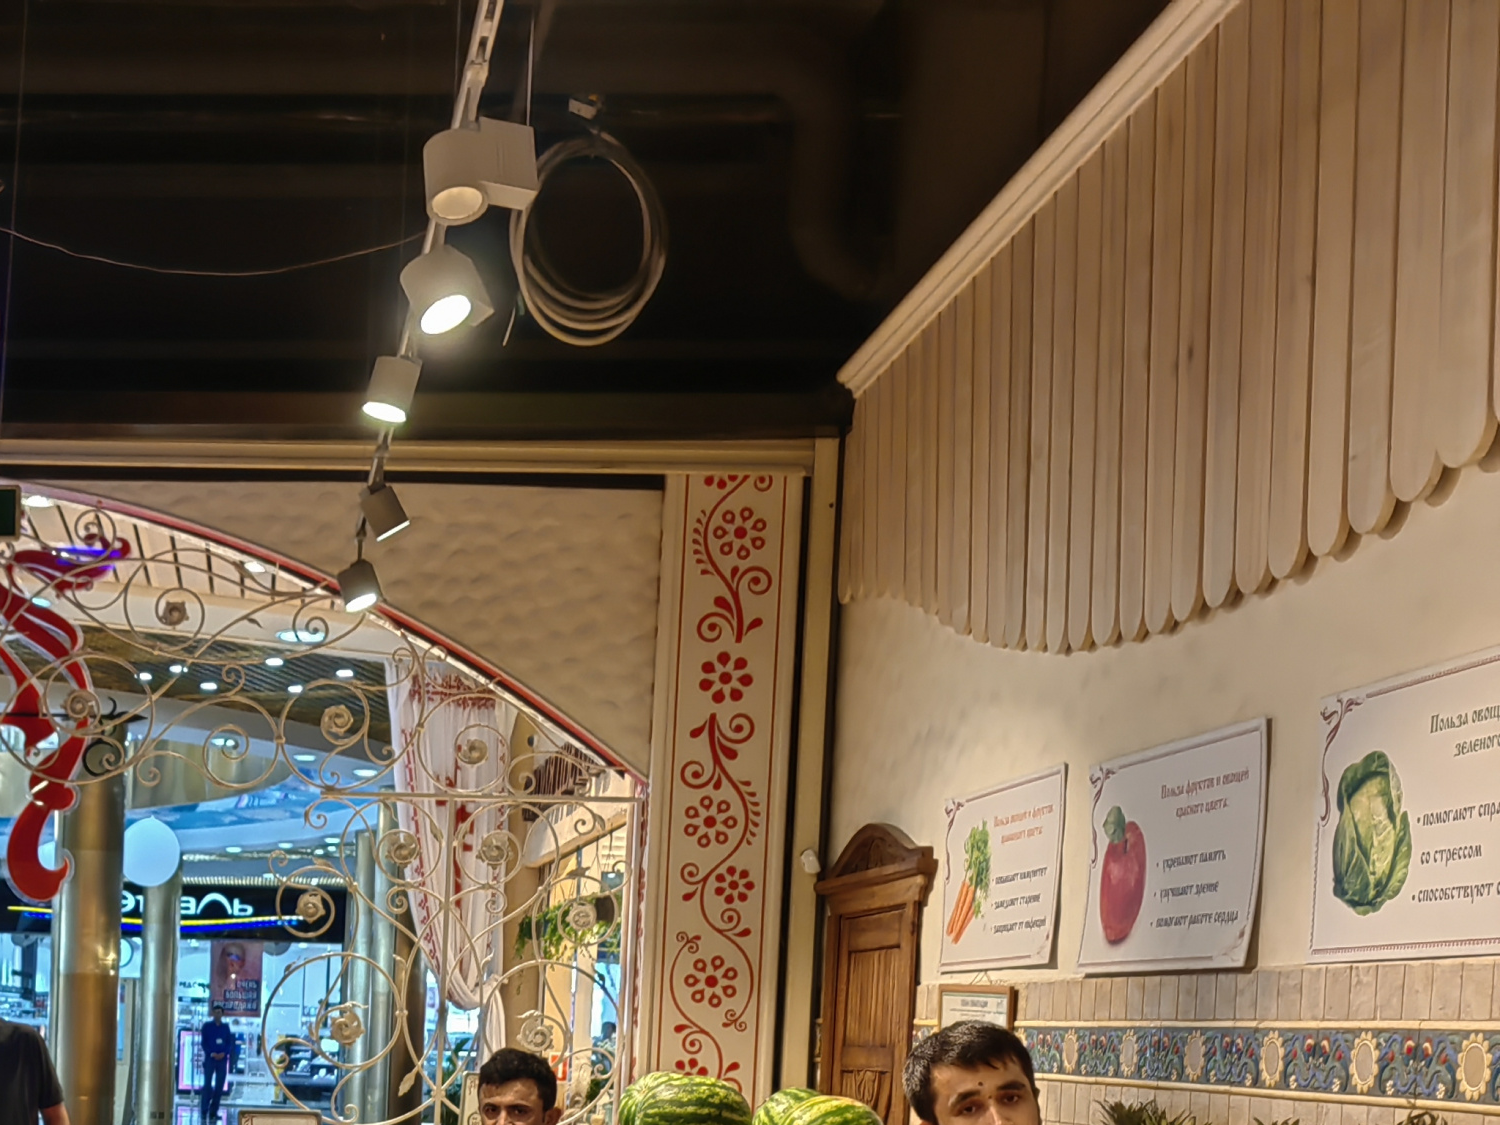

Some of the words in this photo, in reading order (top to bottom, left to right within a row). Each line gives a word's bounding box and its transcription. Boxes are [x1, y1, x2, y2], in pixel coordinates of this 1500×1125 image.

[1430, 712, 1469, 734] Польза
[1422, 805, 1476, 827] помогают
[1420, 851, 1431, 865] со
[1433, 844, 1482, 867] стрессом
[1418, 882, 1494, 904] способствуют
